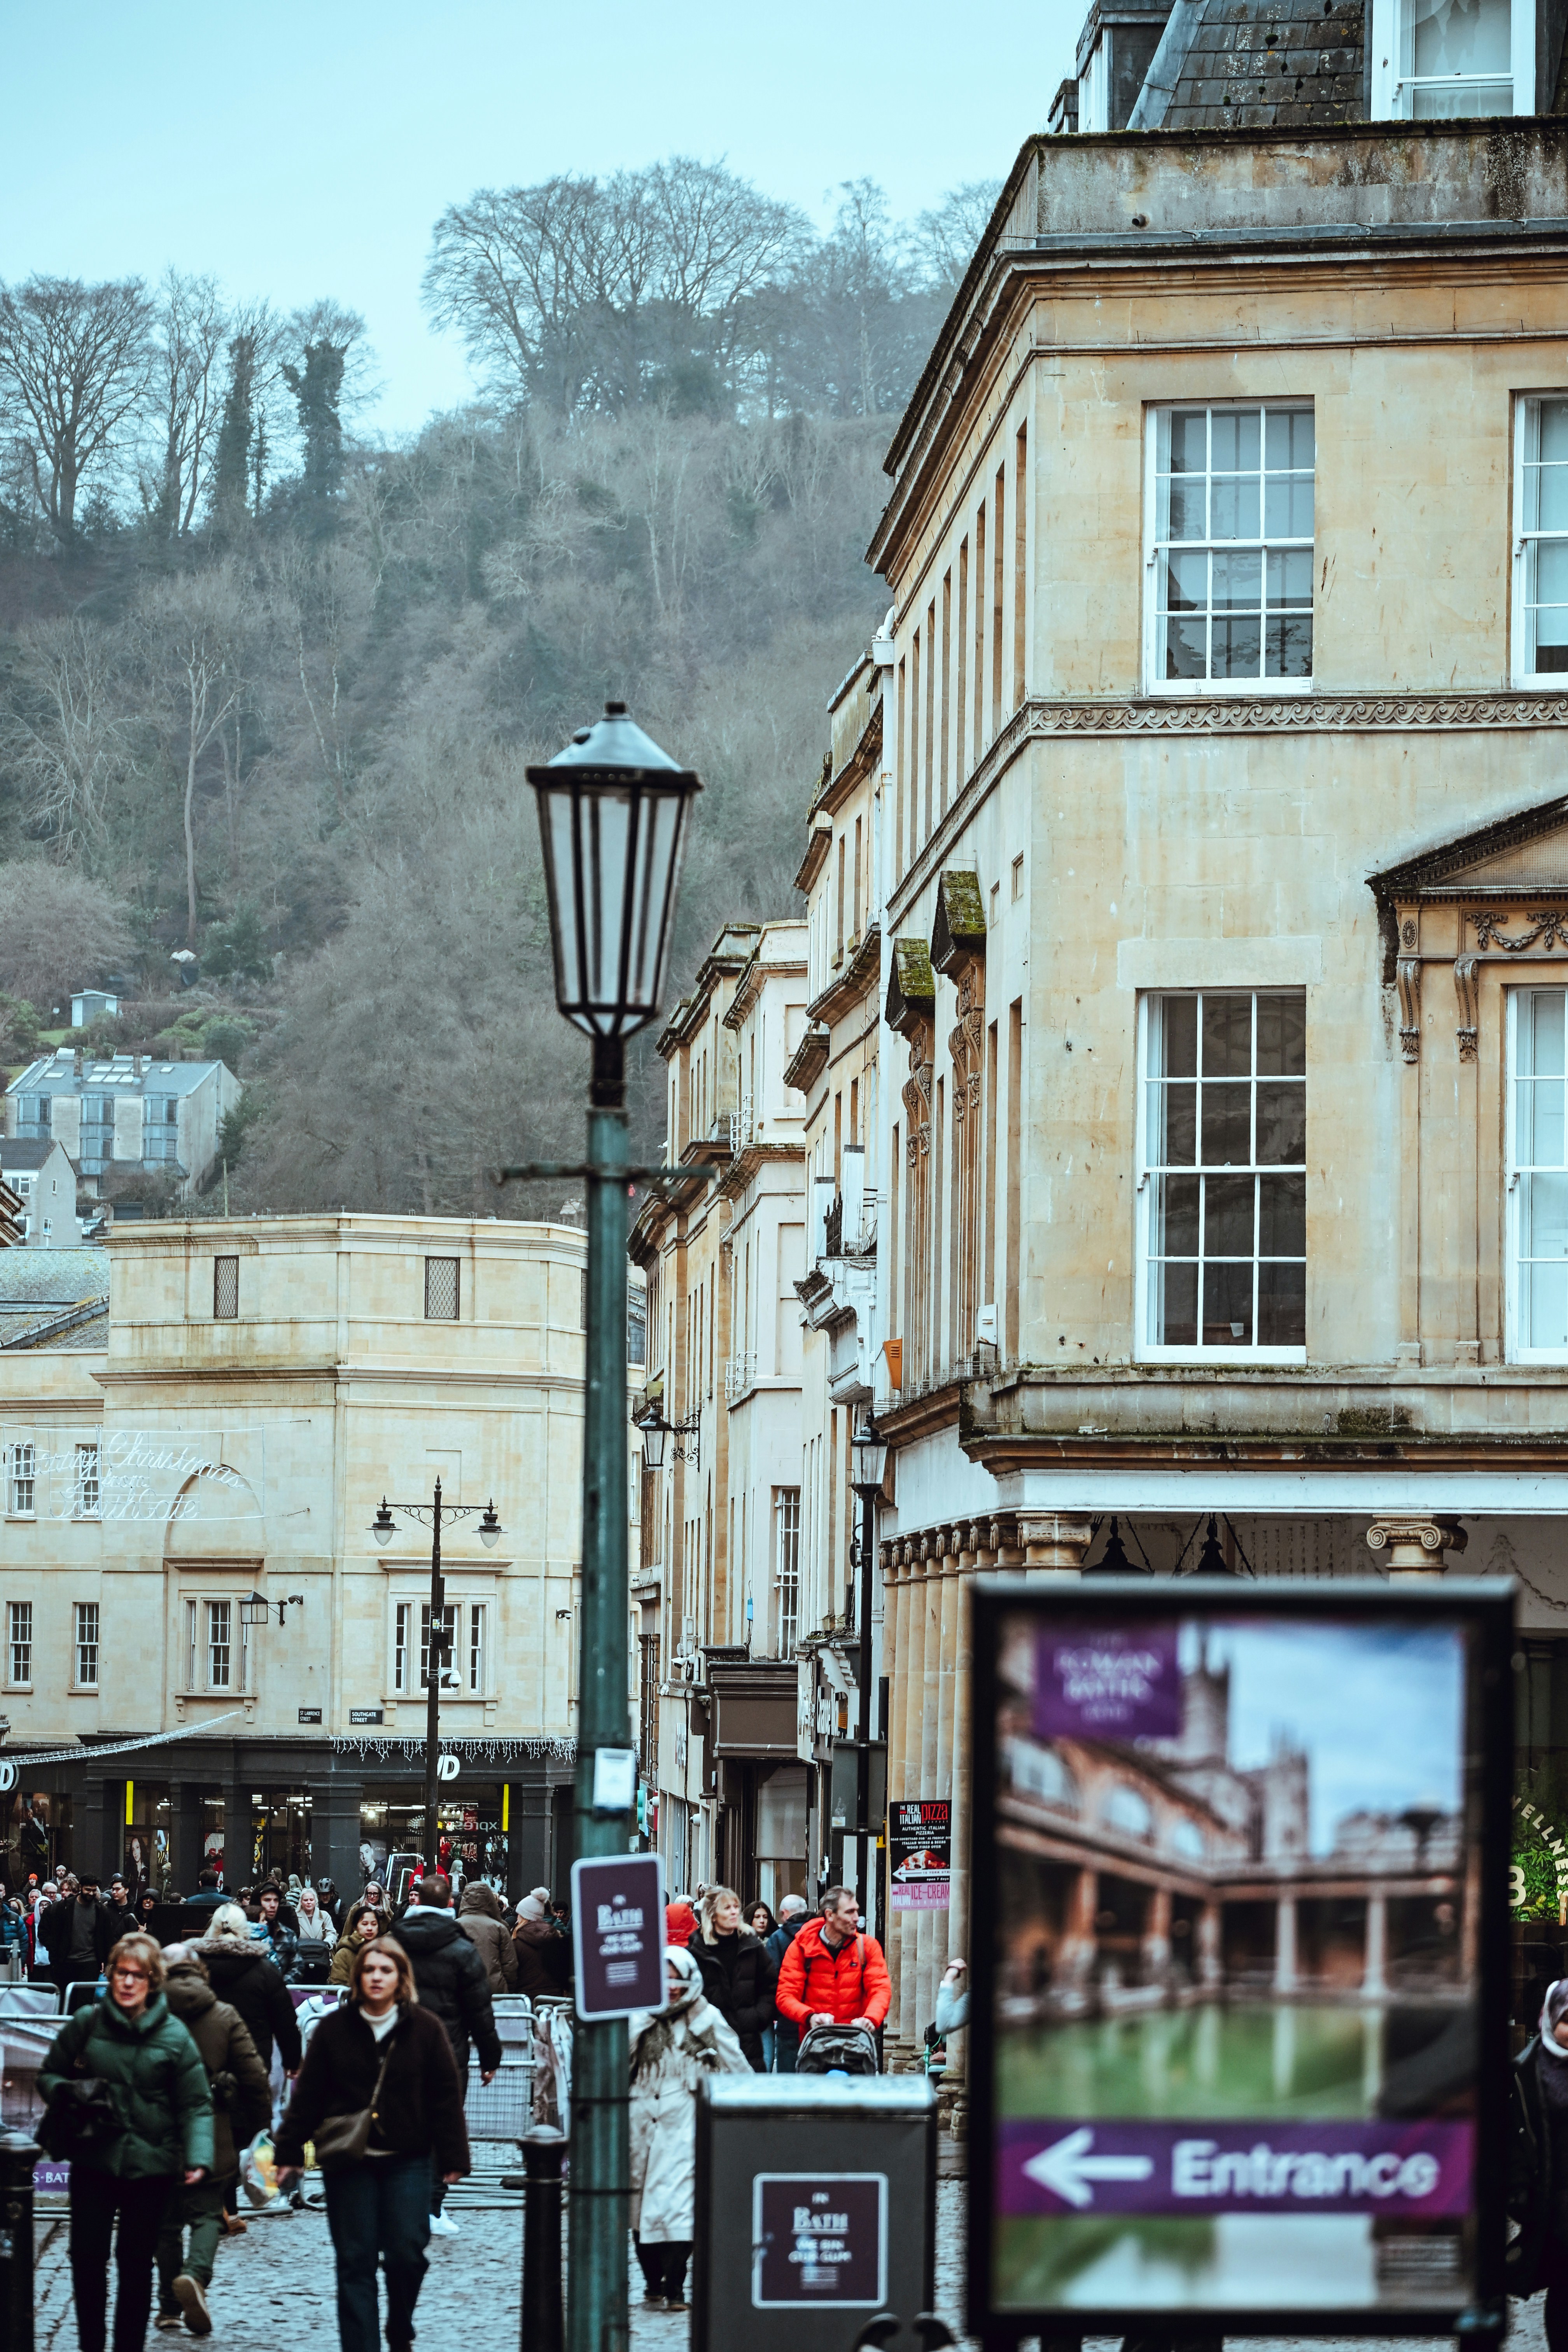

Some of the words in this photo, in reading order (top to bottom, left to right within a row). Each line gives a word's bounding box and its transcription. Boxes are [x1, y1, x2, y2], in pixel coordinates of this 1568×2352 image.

[108, 1432, 244, 1488] Christmas
[907, 1804, 921, 1814] REAL
[921, 1804, 948, 1824] pizza
[900, 1814, 921, 1825] ITALIAN
[899, 1885, 910, 1895] REAL
[1172, 2139, 1439, 2198] Entrance
[793, 2207, 848, 2229] BATH
